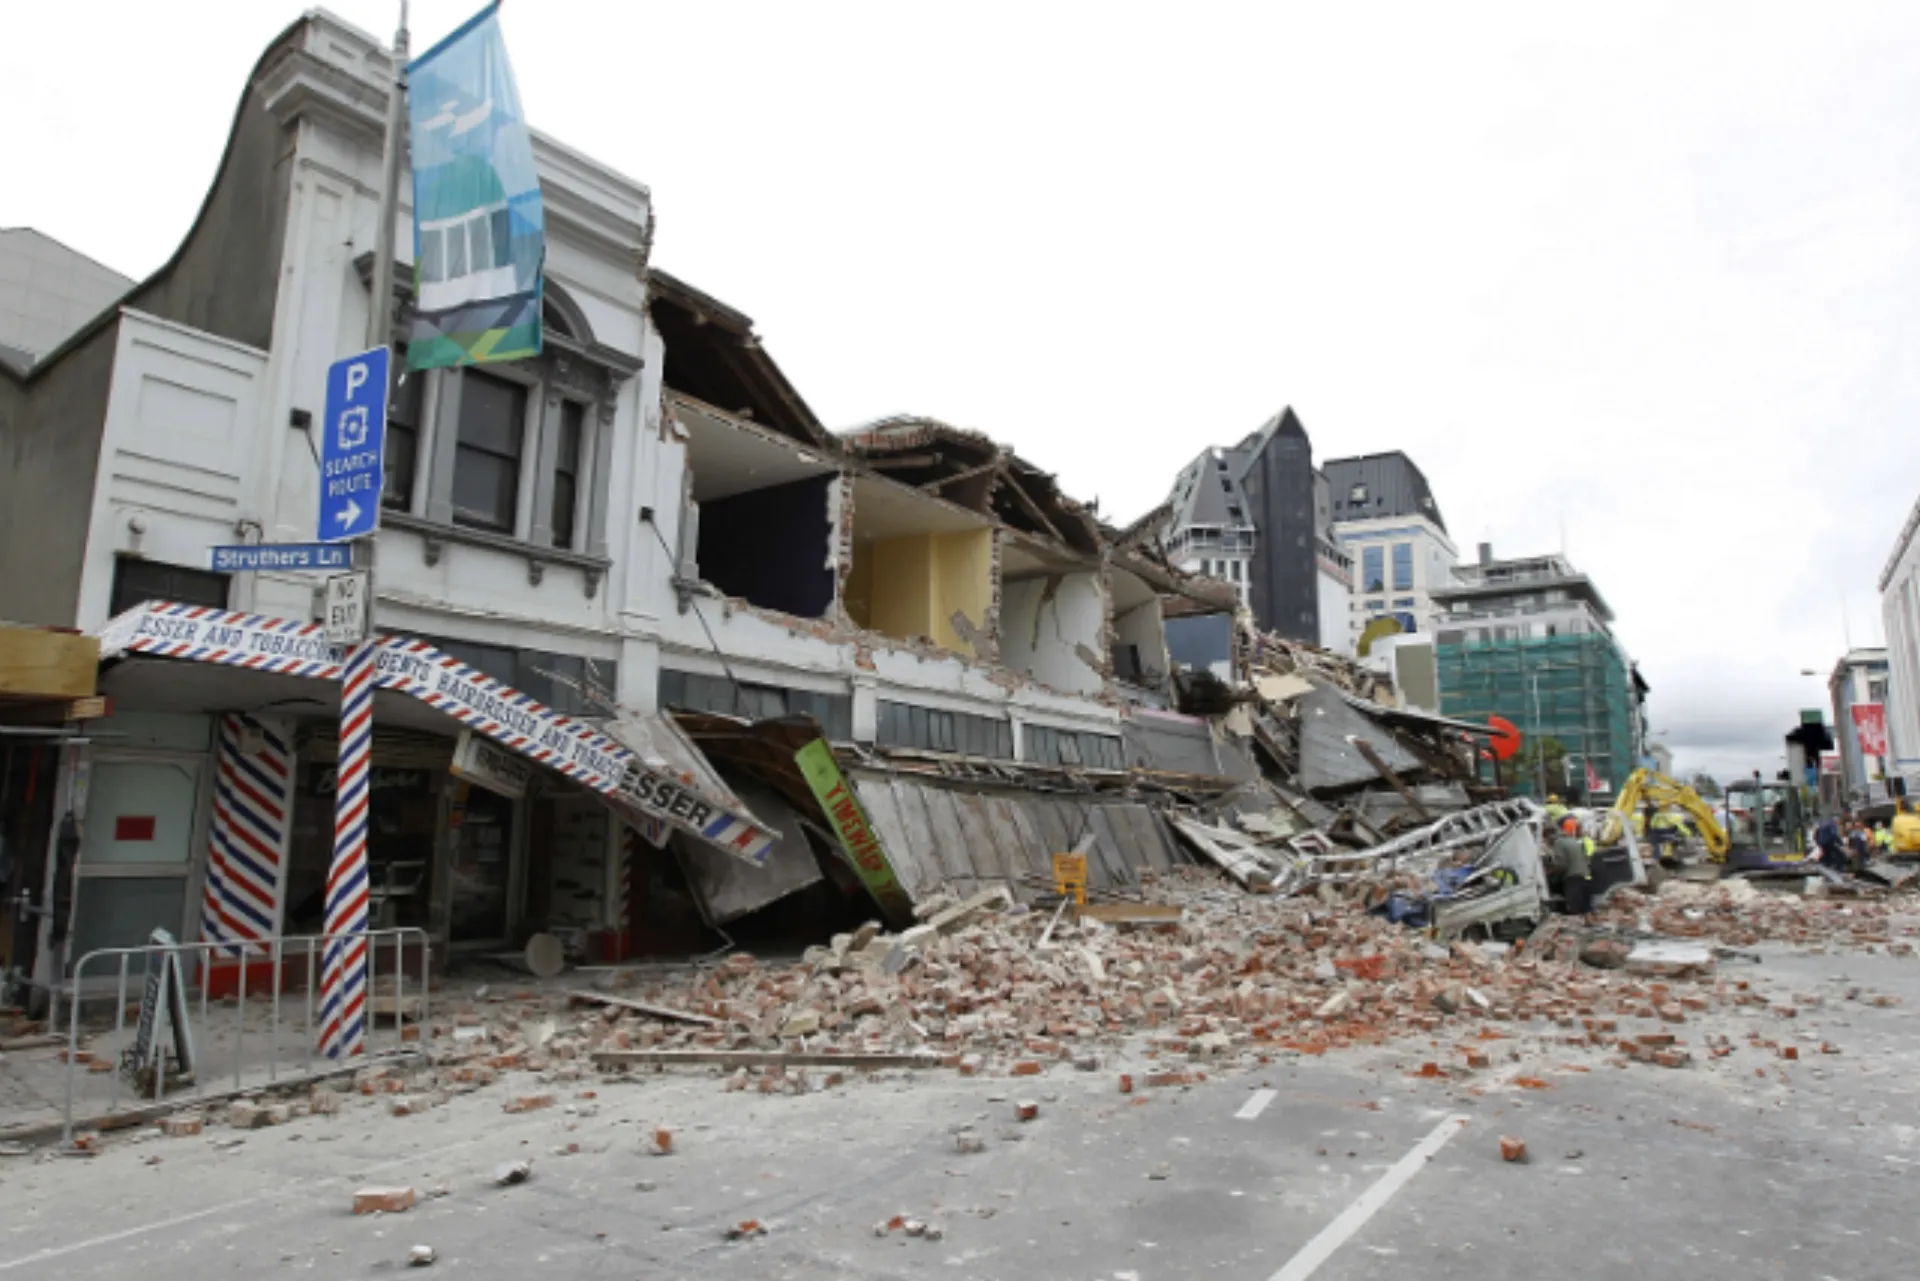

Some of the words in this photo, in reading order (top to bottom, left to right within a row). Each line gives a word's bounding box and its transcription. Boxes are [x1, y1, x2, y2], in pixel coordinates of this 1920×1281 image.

[346, 363, 369, 402] P
[325, 450, 378, 478] SEARCH
[328, 472, 372, 498] ROUTE
[217, 547, 310, 568] Struthers
[317, 546, 343, 566] Ln
[331, 602, 357, 627] EXIT
[203, 624, 243, 648] AND
[376, 650, 431, 681] GENTS
[539, 726, 570, 753] AND
[618, 767, 712, 827] ESSER
